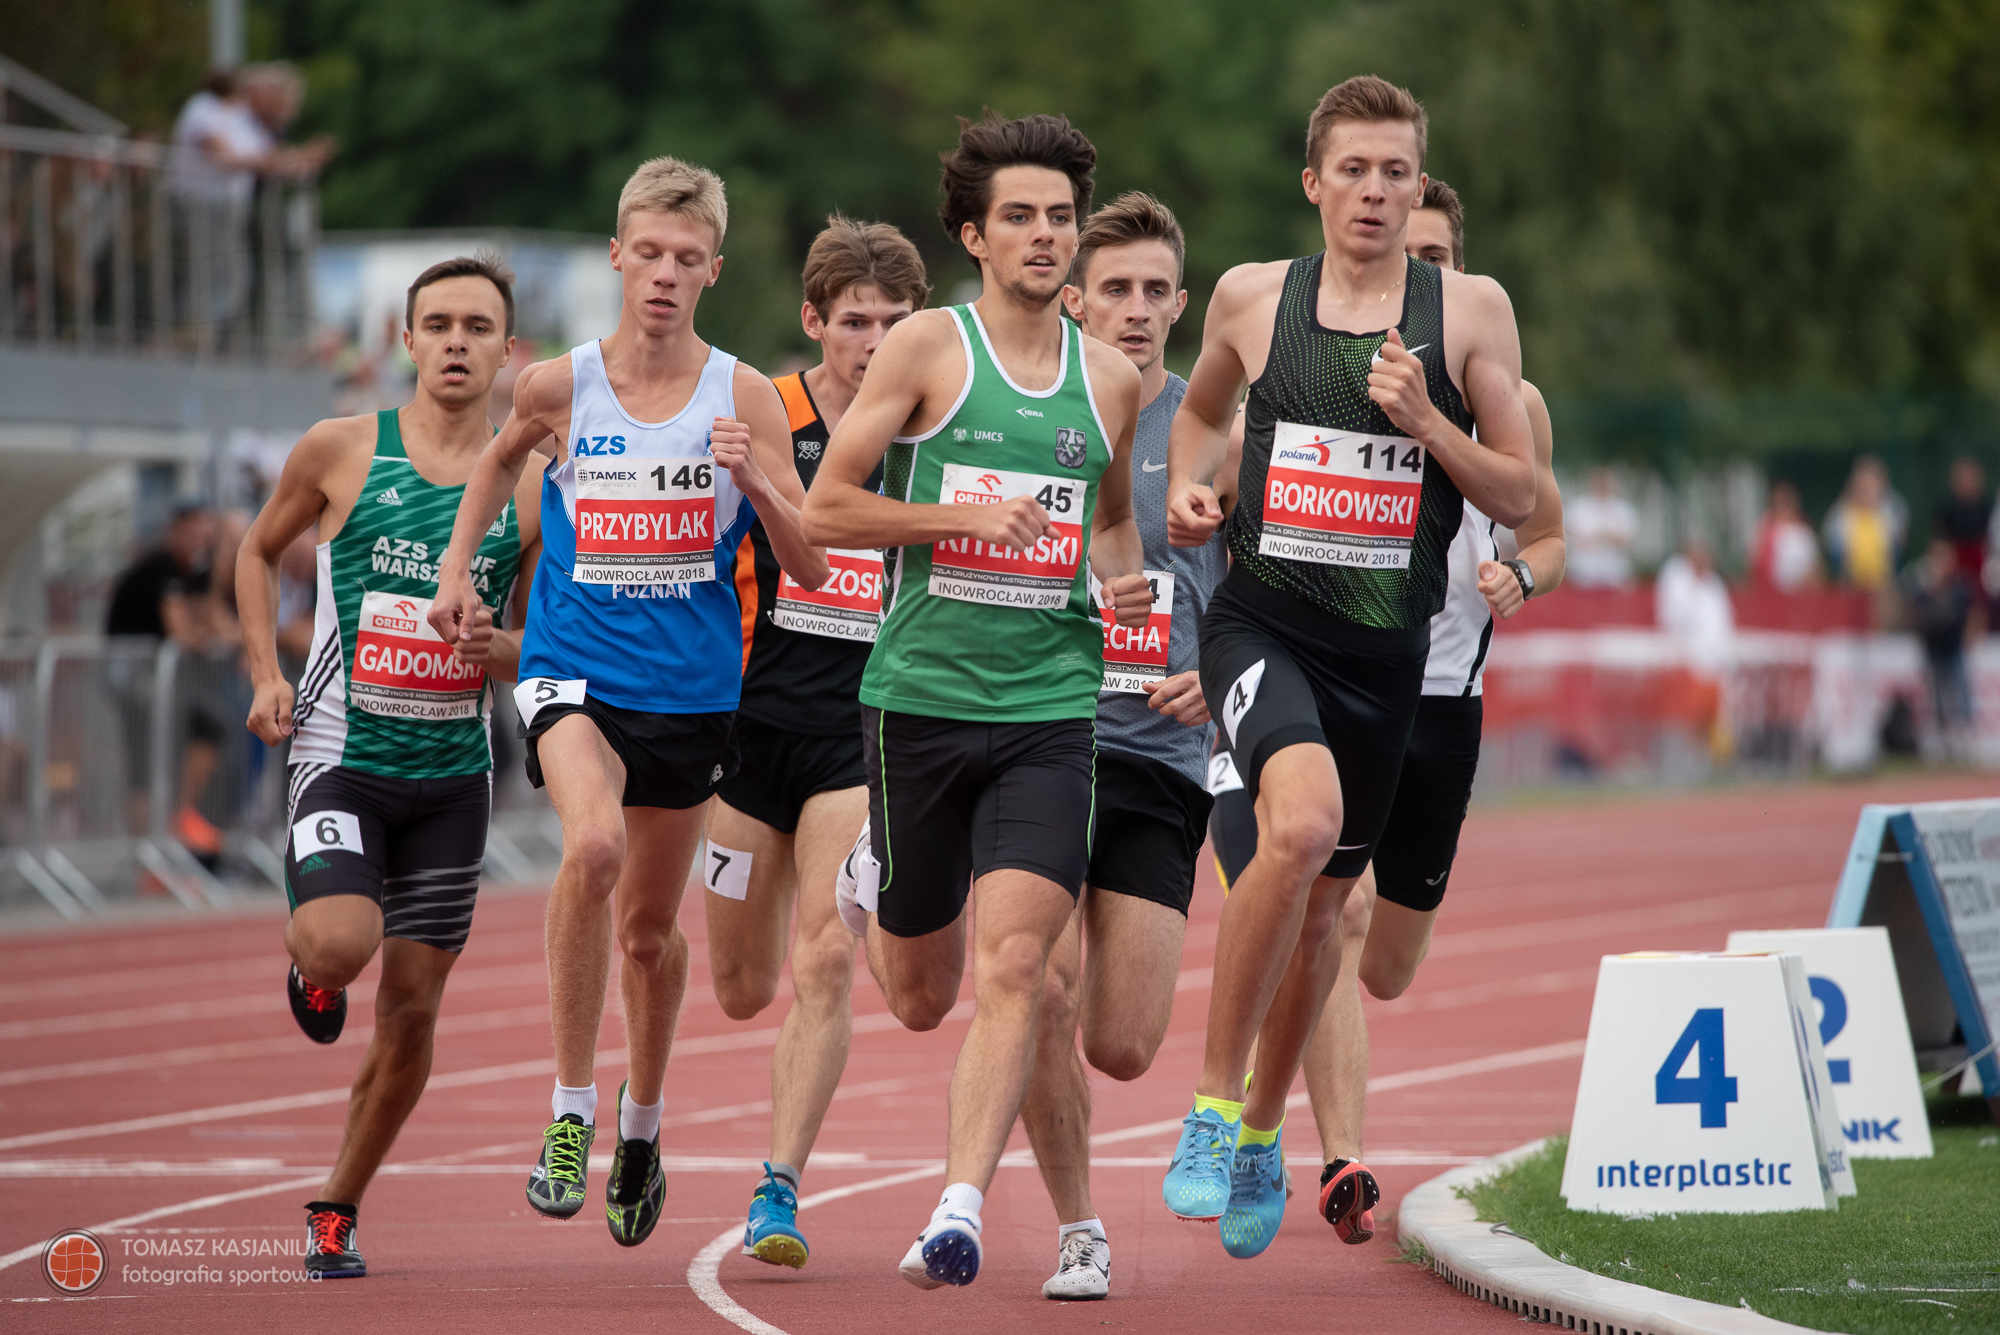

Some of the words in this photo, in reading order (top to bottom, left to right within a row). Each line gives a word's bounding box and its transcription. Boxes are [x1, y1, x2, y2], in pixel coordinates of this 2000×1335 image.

[575, 435, 626, 458] AZS
[974, 430, 1004, 442] UMCS
[1278, 449, 1318, 462] polanik
[1357, 443, 1422, 473] 114
[589, 471, 637, 480] TAMEX
[651, 464, 712, 491] 146
[377, 497, 403, 506] adidas
[956, 492, 1000, 505] ORLEN
[1034, 484, 1073, 513] 45
[1269, 480, 1415, 525] BORKOWSKI
[580, 510, 708, 541] PRZYBYLAK
[1263, 525, 1282, 534] PZLA
[1283, 528, 1329, 541] DRUŻYNOWE
[1330, 535, 1384, 546] MISTRZOSTWA
[372, 535, 428, 560] AZS
[593, 555, 635, 563] DRUŻYNOWE
[1268, 541, 1369, 564] INOWROCŁAW
[1371, 553, 1400, 565] 2018
[582, 569, 675, 582] INOWROCŁAW
[678, 567, 705, 580] 2018
[932, 567, 952, 575] PZLA
[953, 569, 1000, 582] DRUŻYNOWE
[1001, 576, 1051, 587] MISTRZOSTWA
[938, 582, 1035, 605] INOWROCŁAW
[1037, 594, 1062, 606] 2018
[777, 601, 795, 610] PZLA
[796, 604, 840, 617] DRUŻYNOWE
[374, 617, 415, 632] ORLEN
[782, 615, 870, 638] INOWROCŁAW
[1138, 665, 1165, 674] POLSKI
[351, 684, 370, 693] PZLA
[370, 687, 414, 698] DRUŻYNOWE
[534, 680, 559, 704] 5
[1125, 678, 1155, 690] 20
[356, 698, 448, 717] INOWROCŁAW
[448, 704, 469, 716] 2018
[1233, 681, 1248, 717] 4
[1214, 757, 1230, 787] 2
[711, 850, 731, 887] 7
[1807, 975, 1851, 1084] 2
[1655, 1007, 1738, 1129] 4
[1597, 1158, 1792, 1192] interplastic
